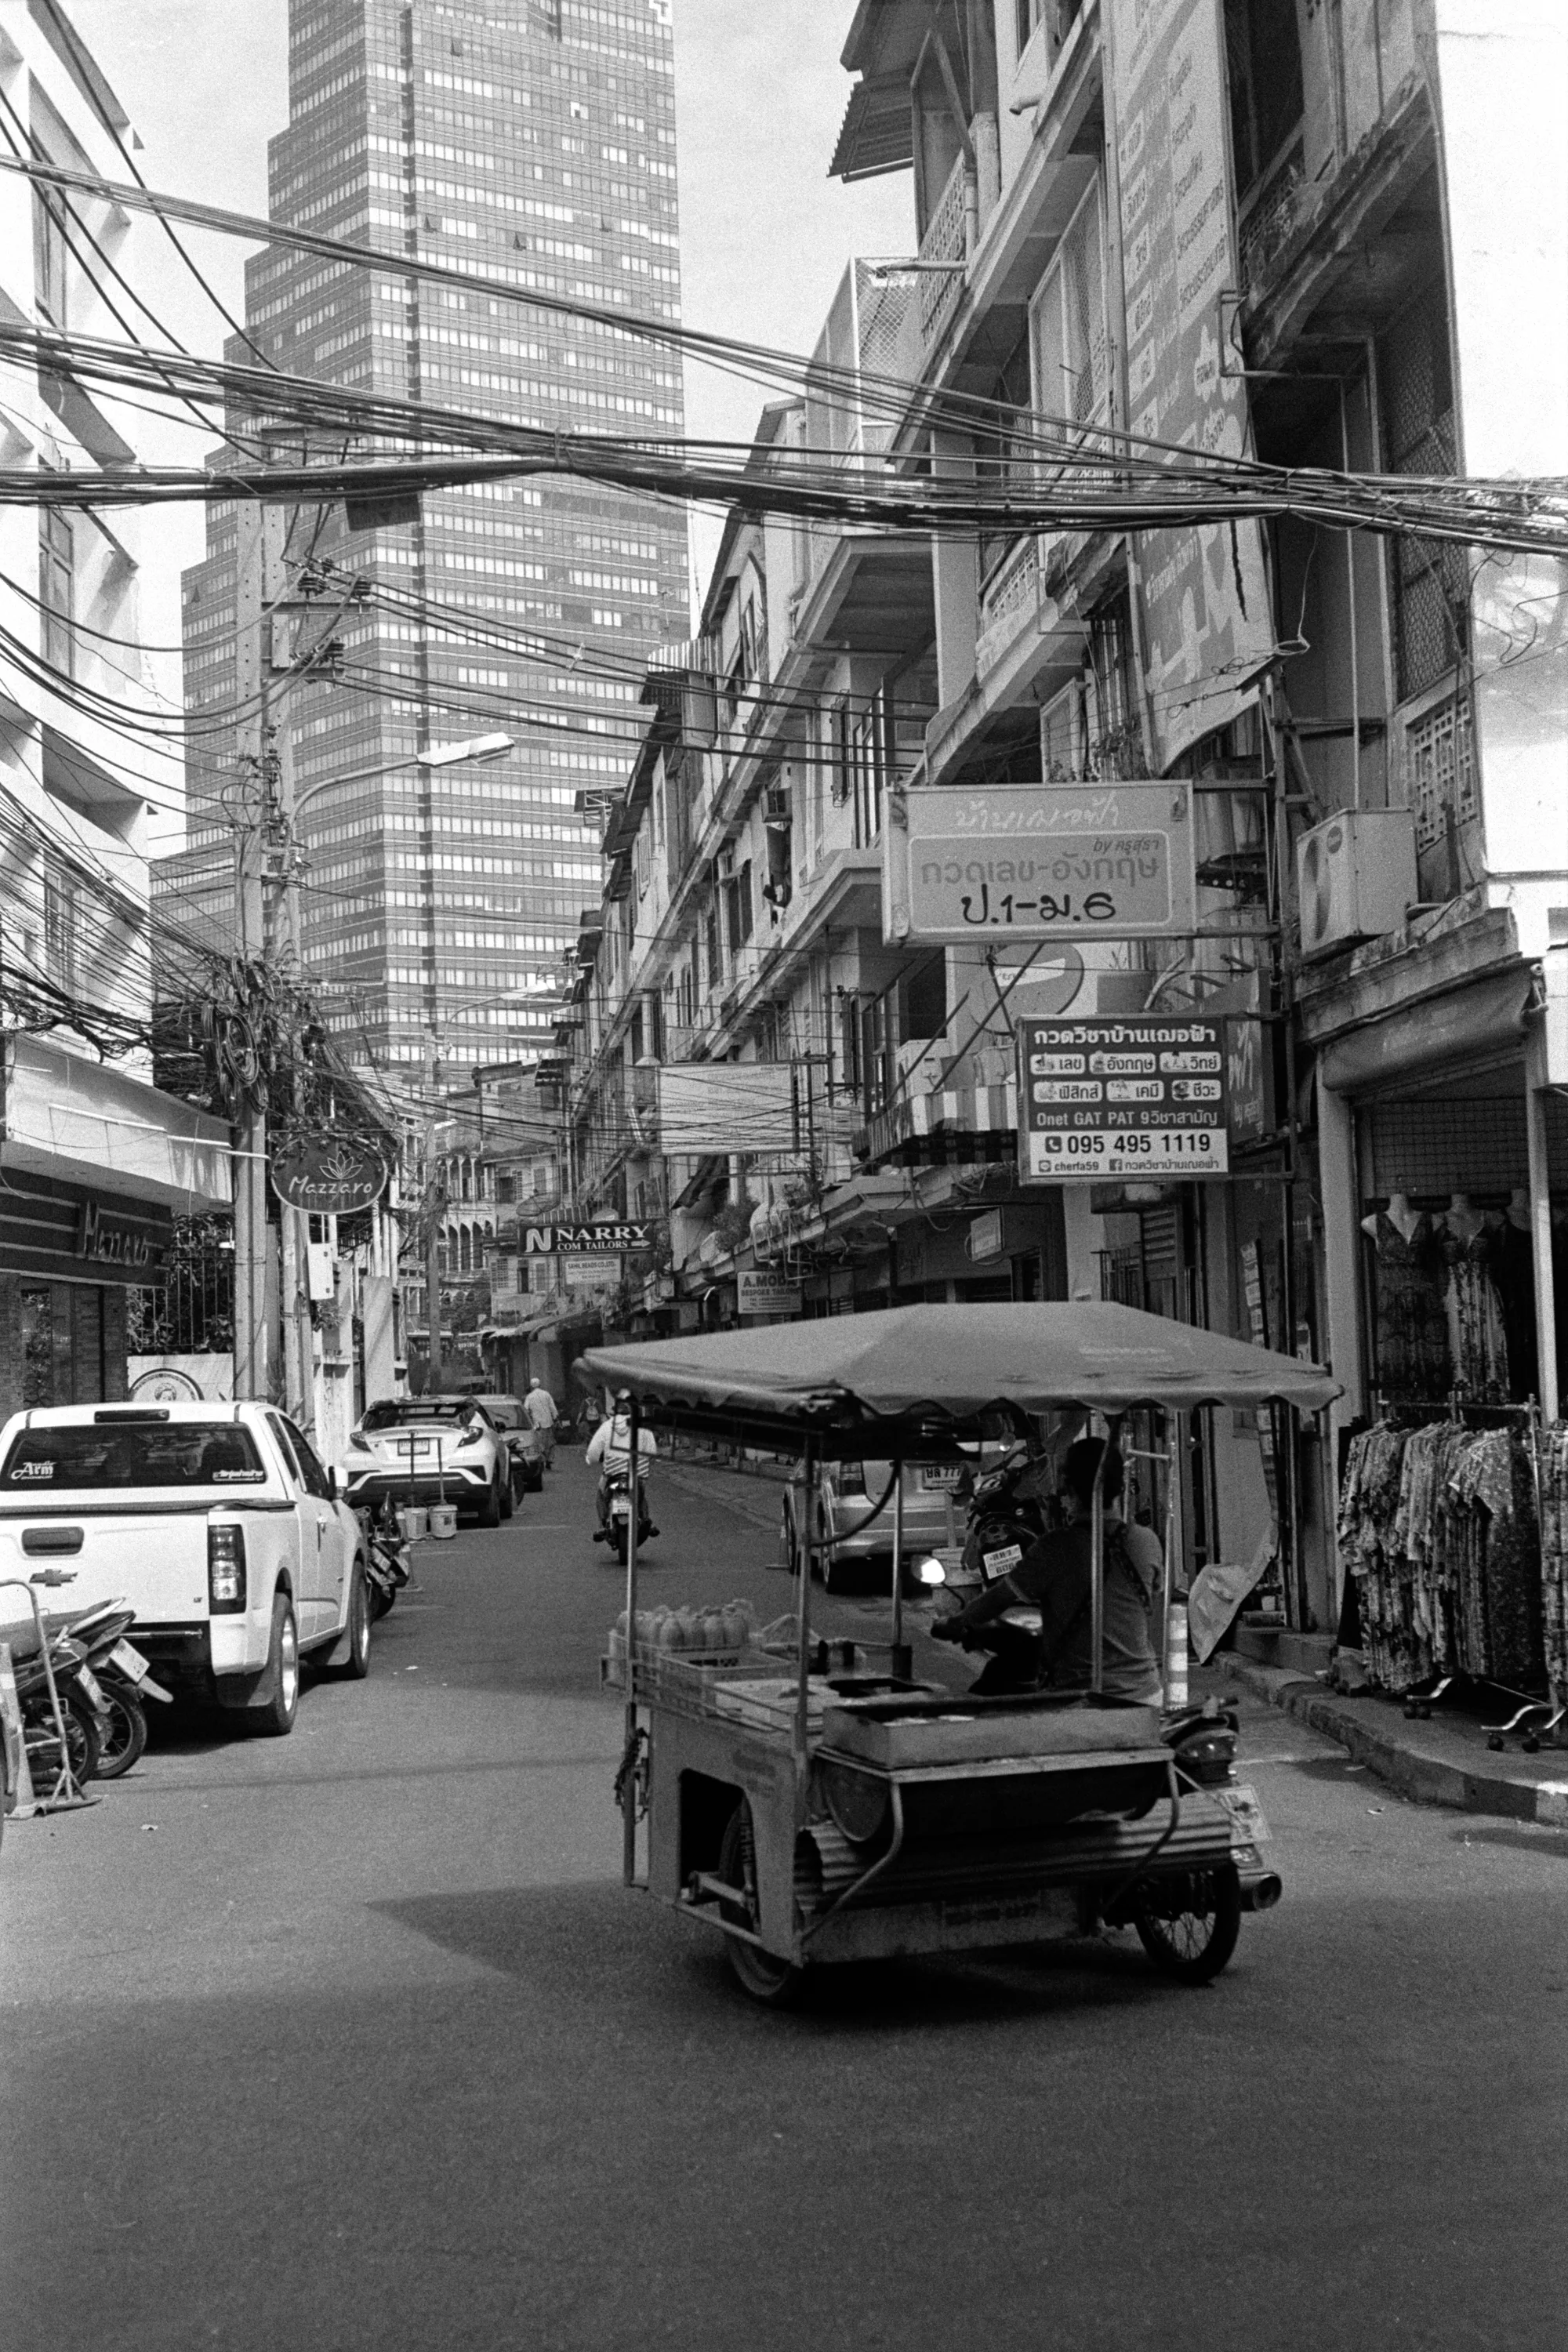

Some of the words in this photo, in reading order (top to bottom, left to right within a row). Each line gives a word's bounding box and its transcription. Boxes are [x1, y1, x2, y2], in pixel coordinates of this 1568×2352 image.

[1093, 838, 1112, 854] by
[1033, 1024, 1216, 1044] กวดวิชาบ้านเฌอฟ้า
[1059, 1058, 1082, 1071] เลข
[1106, 1056, 1154, 1074] อังกฤษ
[1190, 1055, 1218, 1070] วิทย์
[1059, 1081, 1100, 1098] ฟิสิกส์
[1136, 1080, 1160, 1098] เคมี
[1192, 1080, 1216, 1098] ชีวะ
[1036, 1112, 1069, 1126] Onet
[1074, 1111, 1102, 1126] GAT
[1108, 1111, 1135, 1125] PAT
[1068, 1135, 1105, 1154] 095
[1114, 1134, 1152, 1153] 495
[1161, 1134, 1210, 1152] 1119
[289, 1175, 373, 1194] Mazzaro
[556, 1223, 650, 1242] NARRY
[586, 1240, 628, 1250] TAILORS
